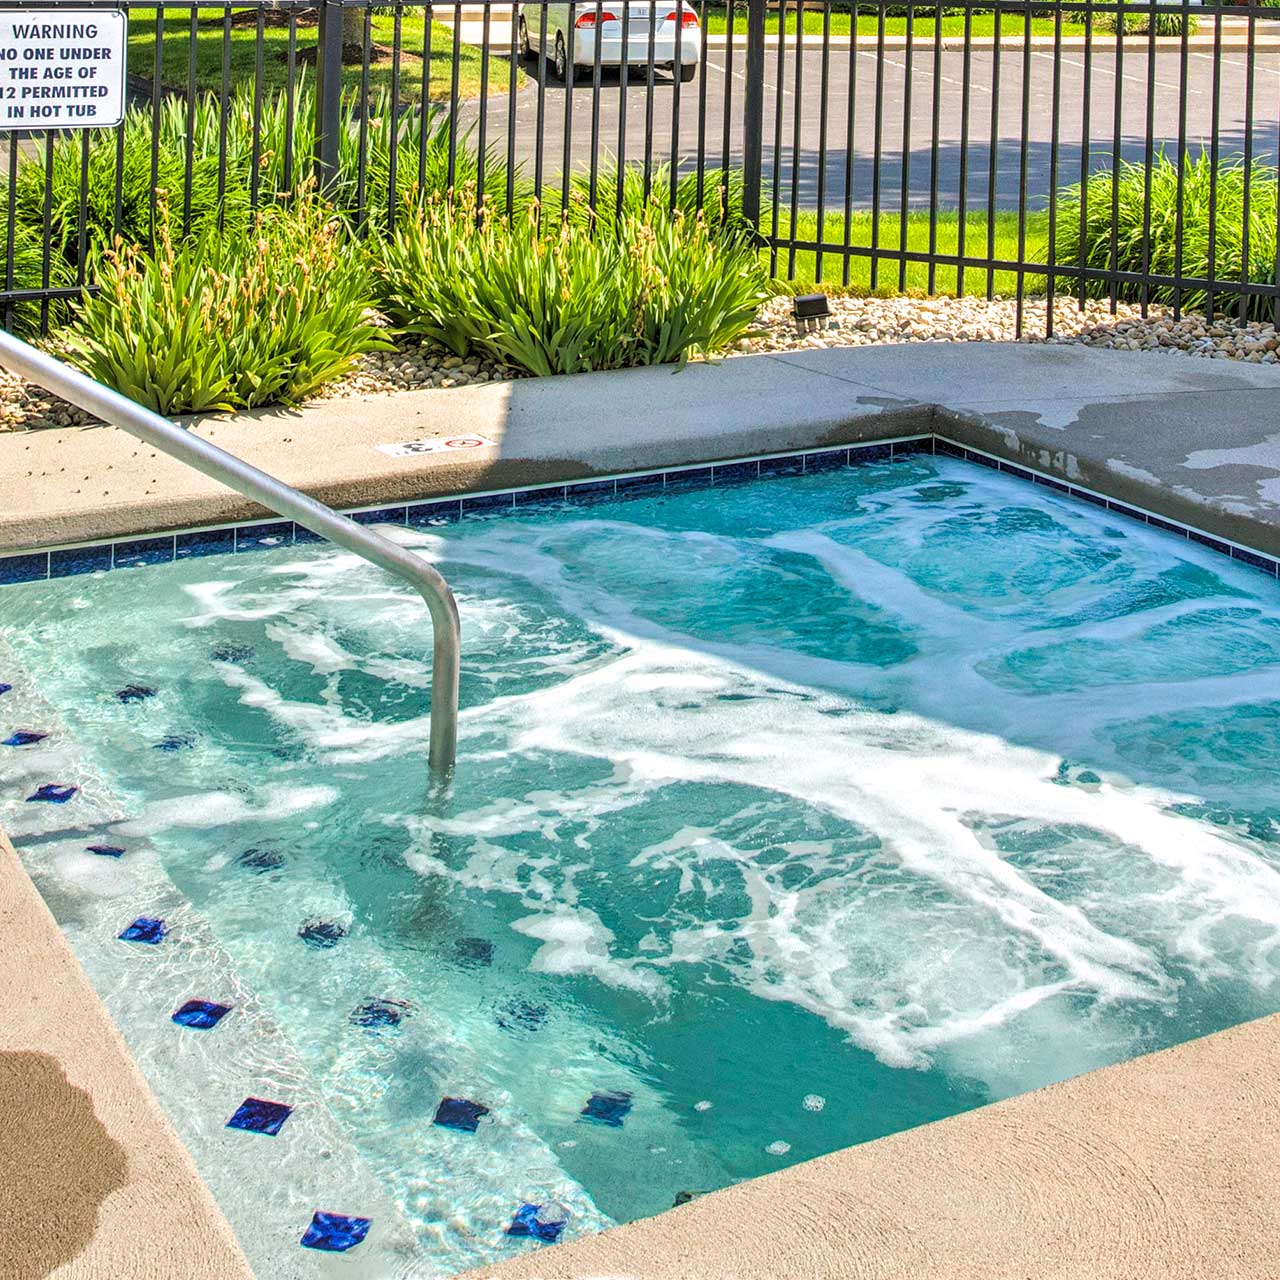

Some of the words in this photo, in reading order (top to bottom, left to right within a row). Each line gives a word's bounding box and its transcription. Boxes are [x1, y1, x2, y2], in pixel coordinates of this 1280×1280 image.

[12, 24, 98, 38] WARNING
[23, 48, 54, 60] ONE
[60, 48, 111, 59] UNDER
[9, 68, 37, 79] THE
[43, 67, 72, 79] AGE
[78, 67, 97, 78] OF
[22, 86, 108, 98] PERMITTED
[8, 106, 24, 118] IN
[30, 105, 63, 117] HOT
[67, 105, 96, 116] TUB
